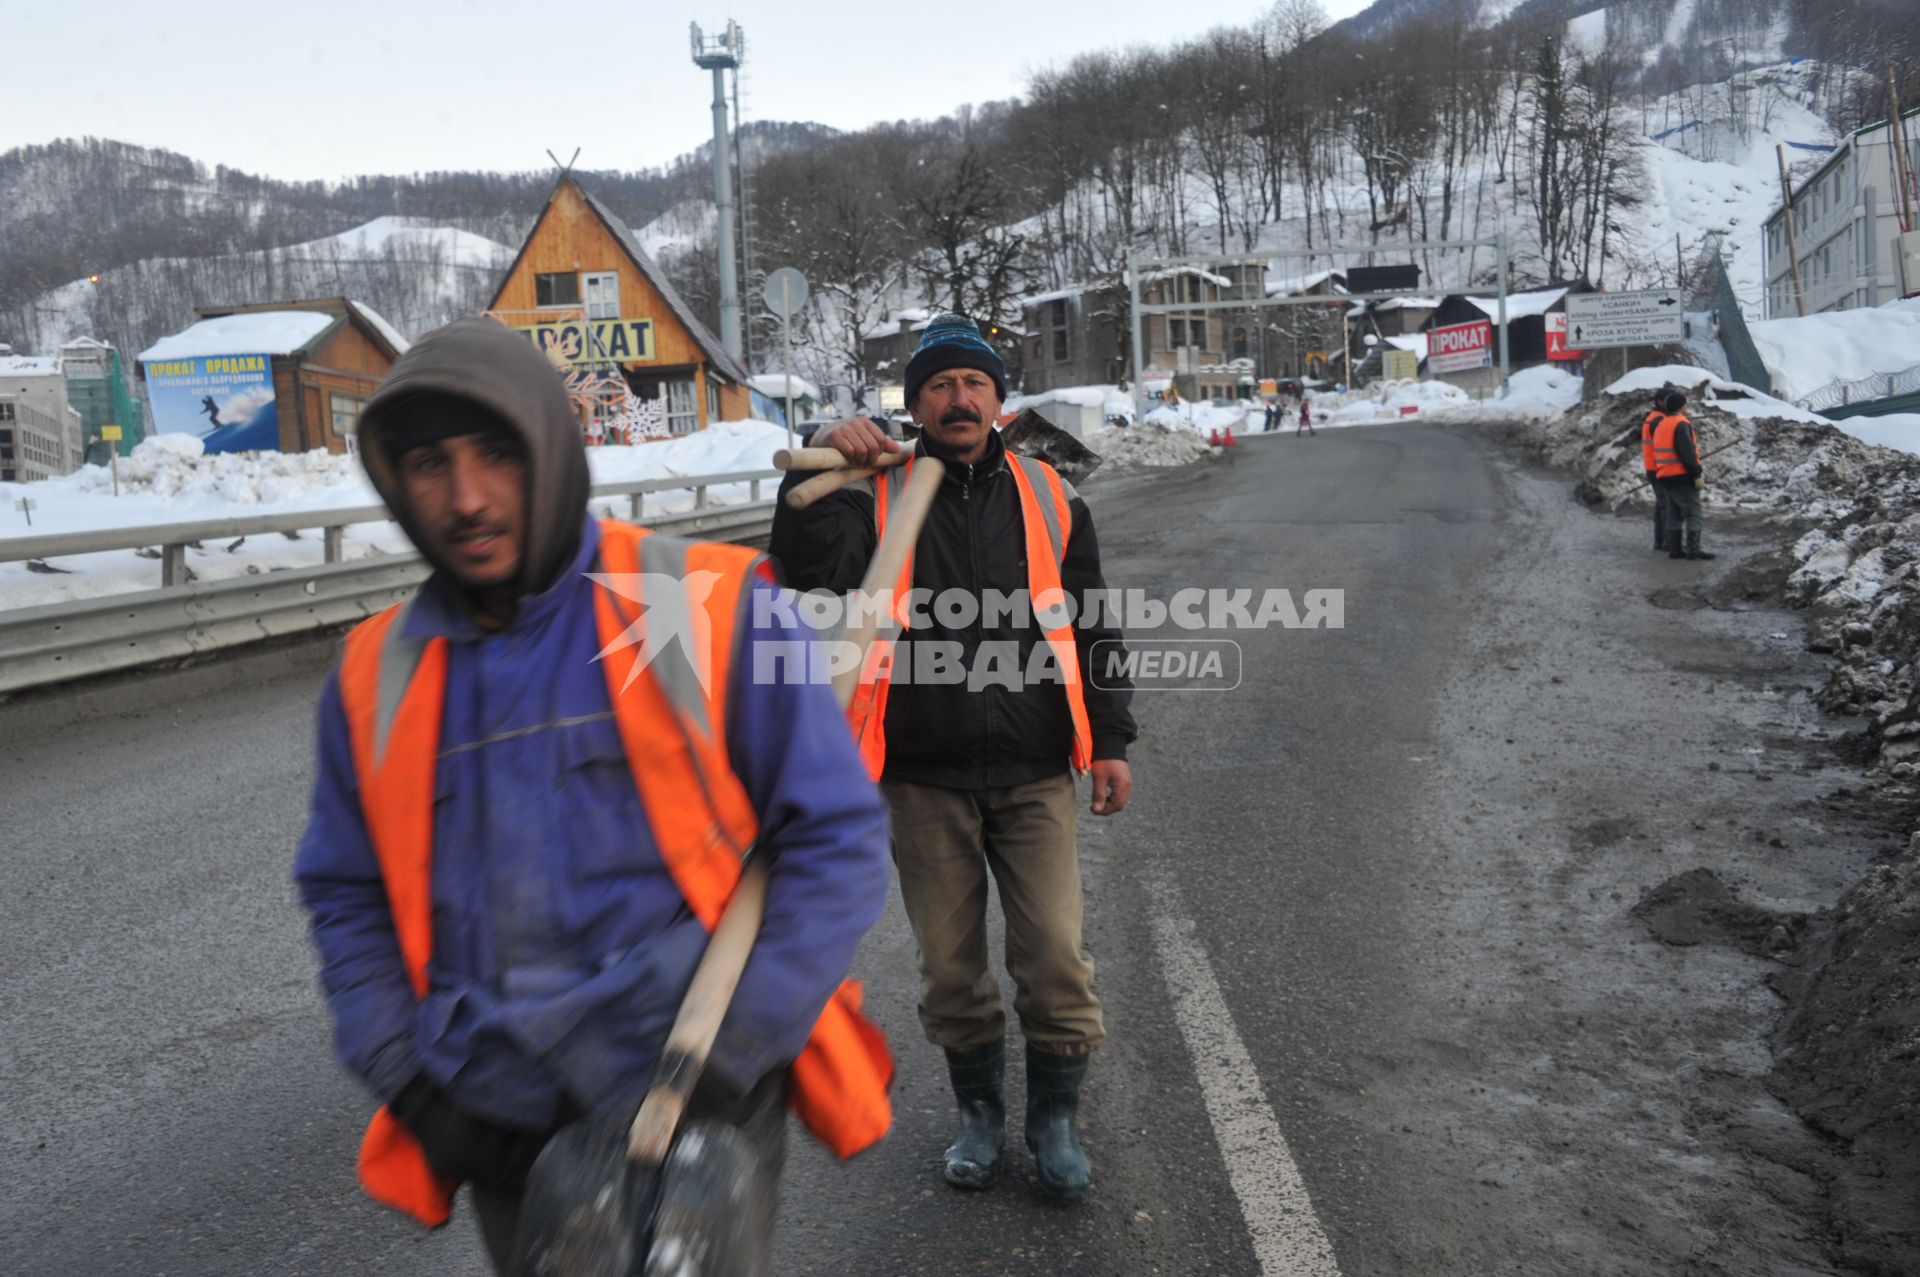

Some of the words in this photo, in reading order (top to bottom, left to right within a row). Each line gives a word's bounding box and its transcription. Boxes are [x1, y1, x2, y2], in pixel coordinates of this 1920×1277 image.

[1571, 312, 1598, 320] sliding
[519, 322, 650, 360] РОКАТ
[1430, 326, 1487, 354] ПРОКАТ
[150, 362, 195, 376] ПРОКАТ
[207, 357, 265, 374] ПРОДАЖА
